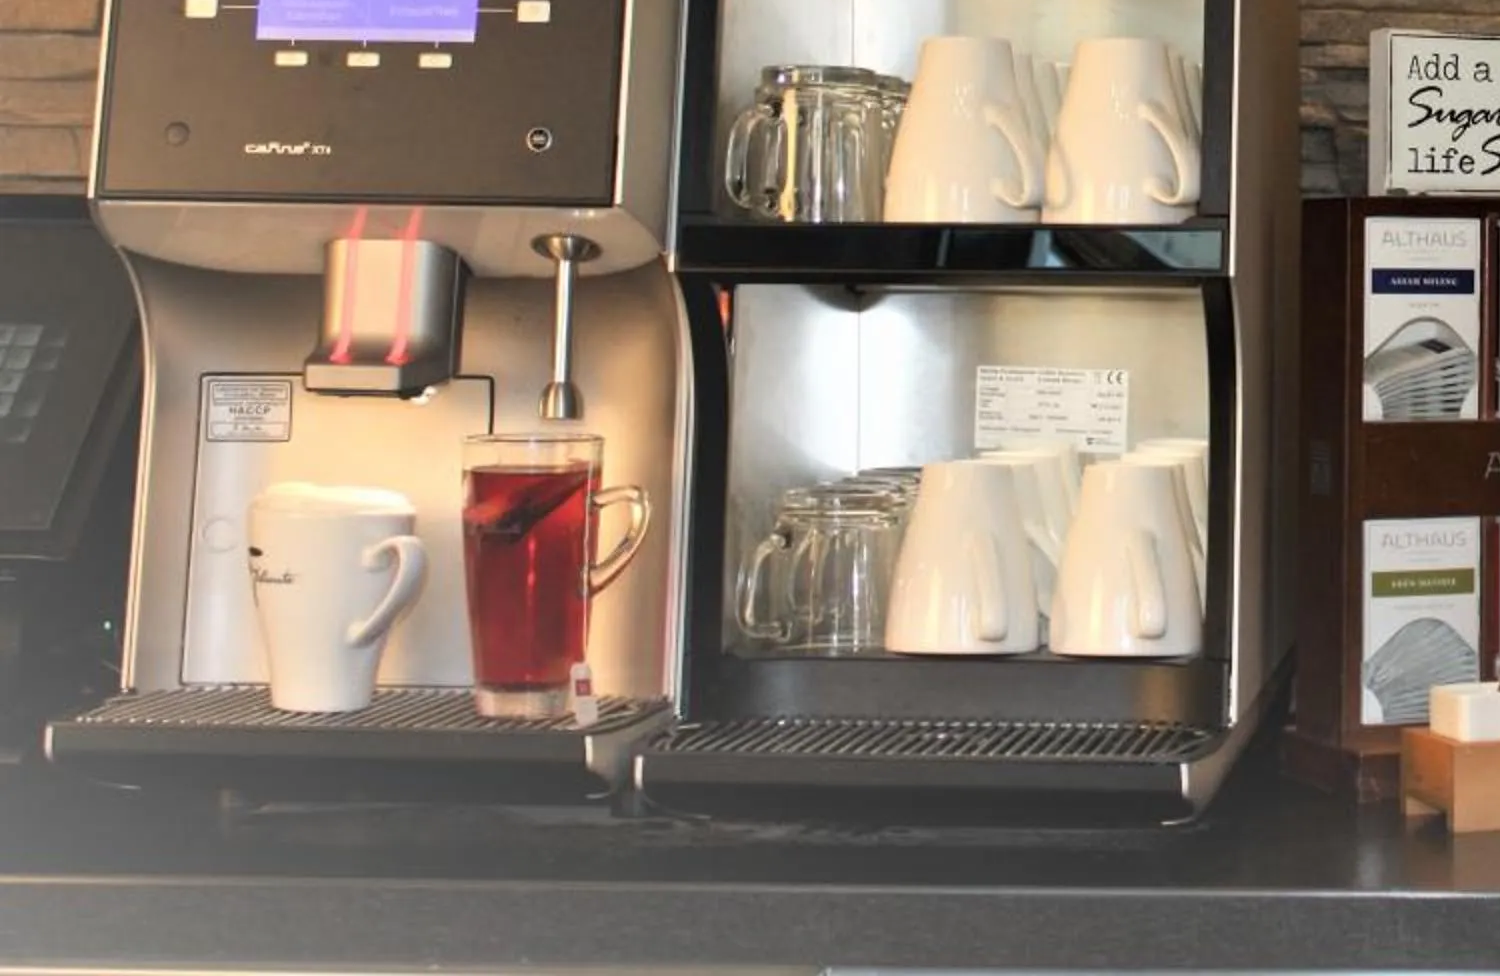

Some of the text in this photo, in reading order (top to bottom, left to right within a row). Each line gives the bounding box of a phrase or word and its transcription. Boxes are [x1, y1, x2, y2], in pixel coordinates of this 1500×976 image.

[1408, 53, 1461, 81] Add
[1473, 61, 1493, 82] a
[1407, 146, 1475, 174] life
[1380, 230, 1468, 249] ALTHAUS
[1380, 530, 1468, 549] ALTHAUS
